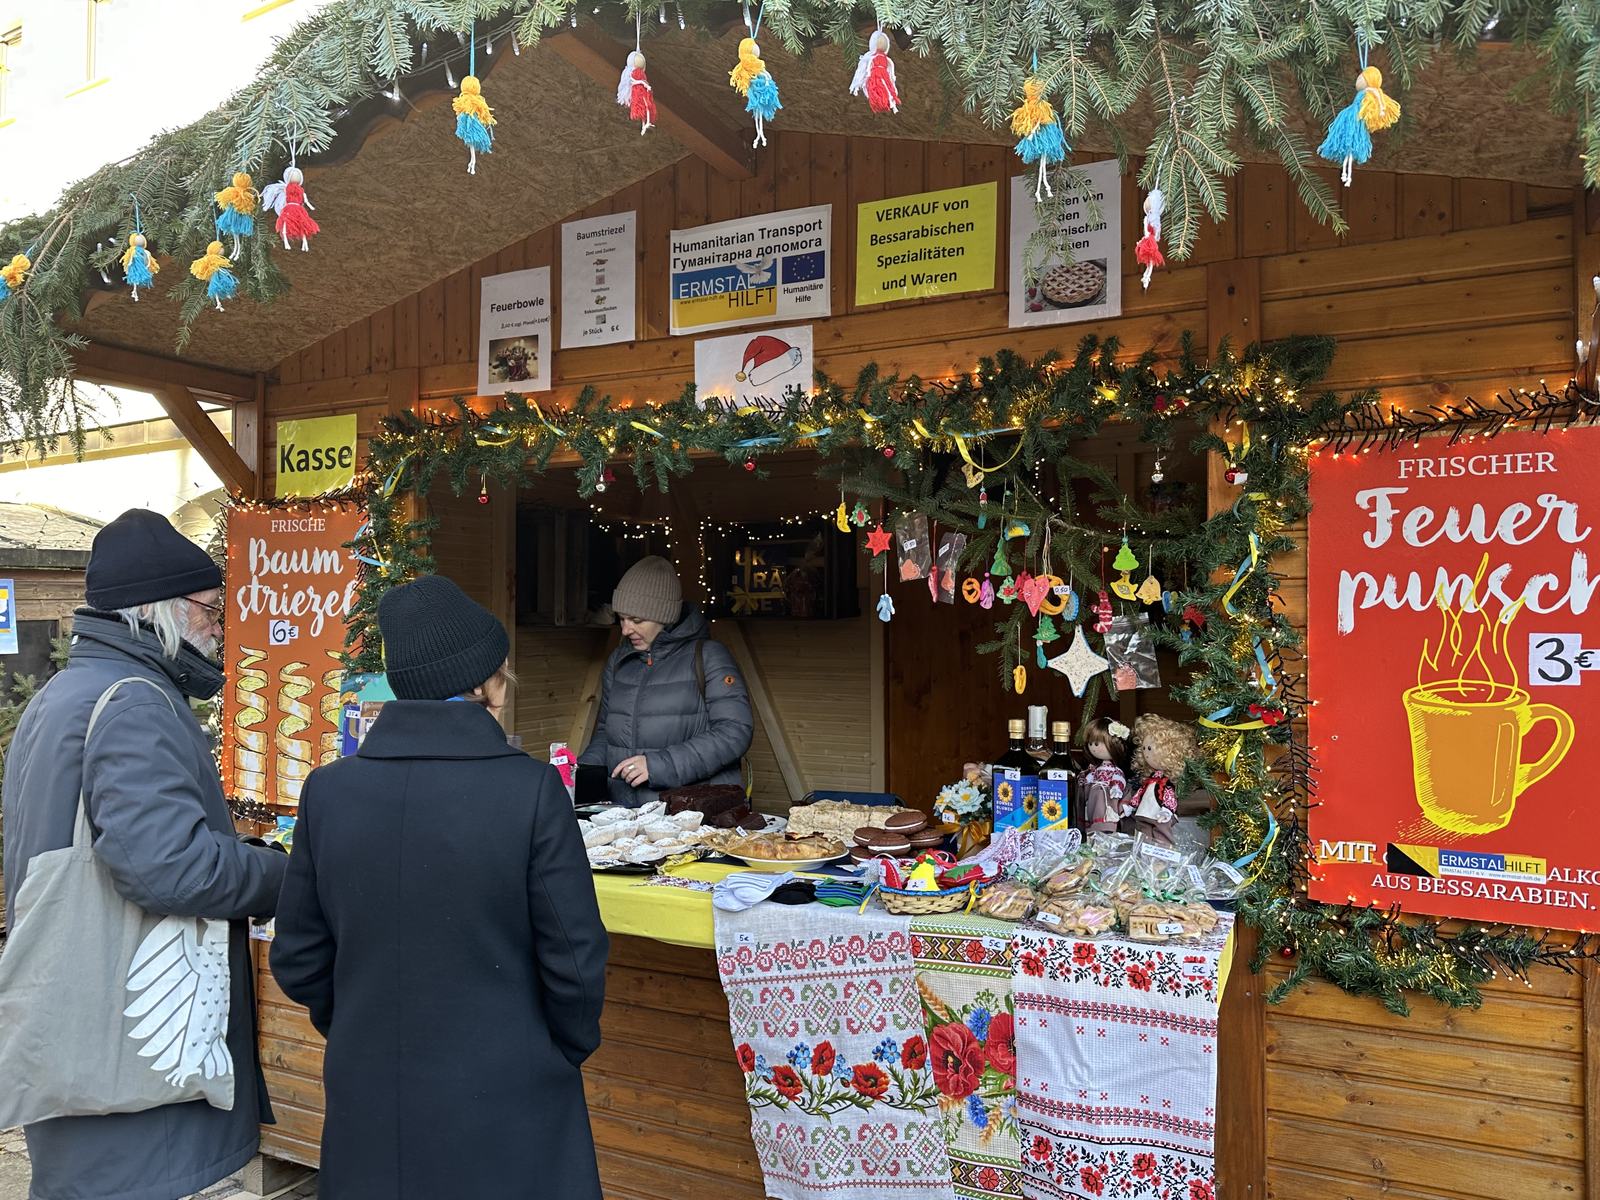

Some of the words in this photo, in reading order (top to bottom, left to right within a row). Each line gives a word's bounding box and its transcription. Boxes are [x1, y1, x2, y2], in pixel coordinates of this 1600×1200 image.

[876, 202, 939, 222] VERKAUF
[943, 199, 969, 211] von
[576, 224, 626, 241] Baumstriezel
[673, 232, 754, 254] Humanitarian
[758, 219, 823, 240] Transport
[870, 221, 974, 247] Bessarabischen
[673, 249, 752, 271] Гуманітарна
[755, 237, 822, 258] допомога
[877, 246, 965, 269] Spezialitäten
[679, 272, 756, 299] ERMSTAL
[783, 283, 824, 294] Humanitäre
[882, 275, 907, 290] und
[911, 271, 957, 286] Waren
[490, 297, 545, 313] Feuerbowle
[728, 287, 776, 308] HILFT
[795, 295, 812, 304] Hilfe
[280, 444, 353, 474] Kasse
[1397, 451, 1558, 479] FRISCHER
[270, 518, 326, 533] FRISCHE
[1355, 486, 1593, 549] Feuer
[249, 537, 344, 577] Baum
[236, 574, 359, 638] striezel
[1319, 839, 1377, 863] MIT
[1371, 873, 1411, 890] AUS
[1416, 875, 1597, 911] BESSARABIEN.
[739, 932, 750, 941] 5€
[988, 938, 1001, 948] 5€
[1191, 965, 1206, 974] 5€
